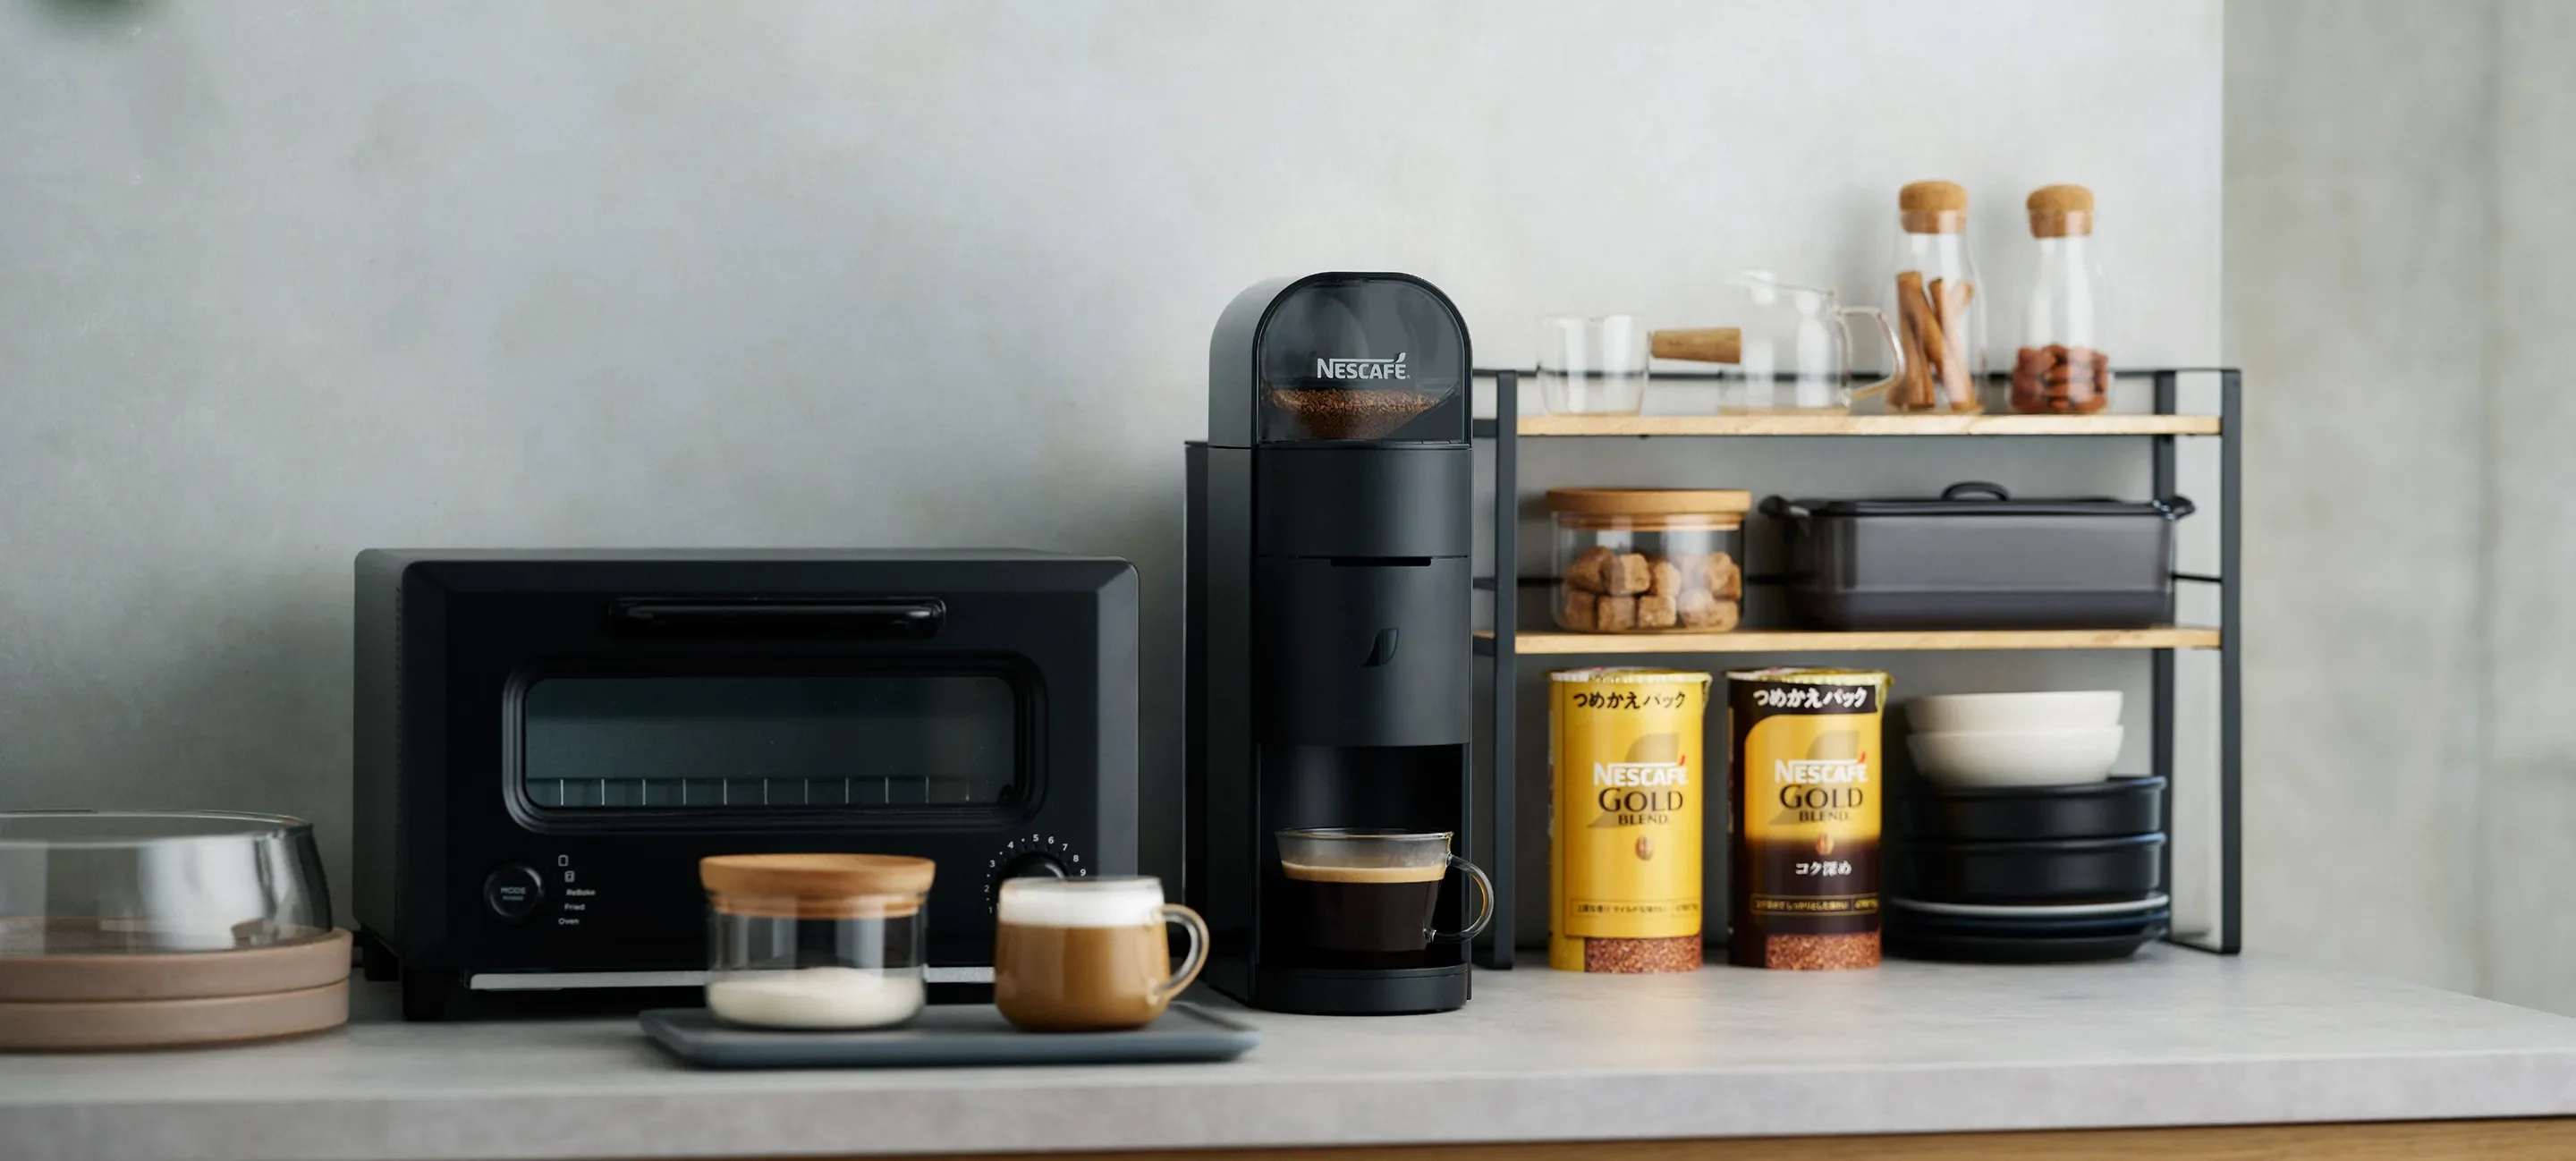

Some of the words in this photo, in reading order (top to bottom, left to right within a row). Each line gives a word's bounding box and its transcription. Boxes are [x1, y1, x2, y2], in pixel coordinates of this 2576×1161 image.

[1573, 691, 1686, 709] つめかえパック
[1753, 687, 1868, 708] つめかえパック
[1598, 787, 1683, 812] GOLD
[1779, 784, 1863, 809] GOLD
[1618, 814, 1669, 825] BLEND
[1799, 810, 1849, 822] BLEND
[984, 885, 990, 893] 2
[989, 860, 996, 868] 3
[1007, 841, 1014, 849] 4
[1033, 834, 1039, 842] 5
[1047, 836, 1055, 844] 6
[1063, 843, 1068, 852] 7
[1073, 854, 1080, 862] 8
[1080, 869, 1087, 877] 9
[1795, 860, 1852, 877] コク深め
